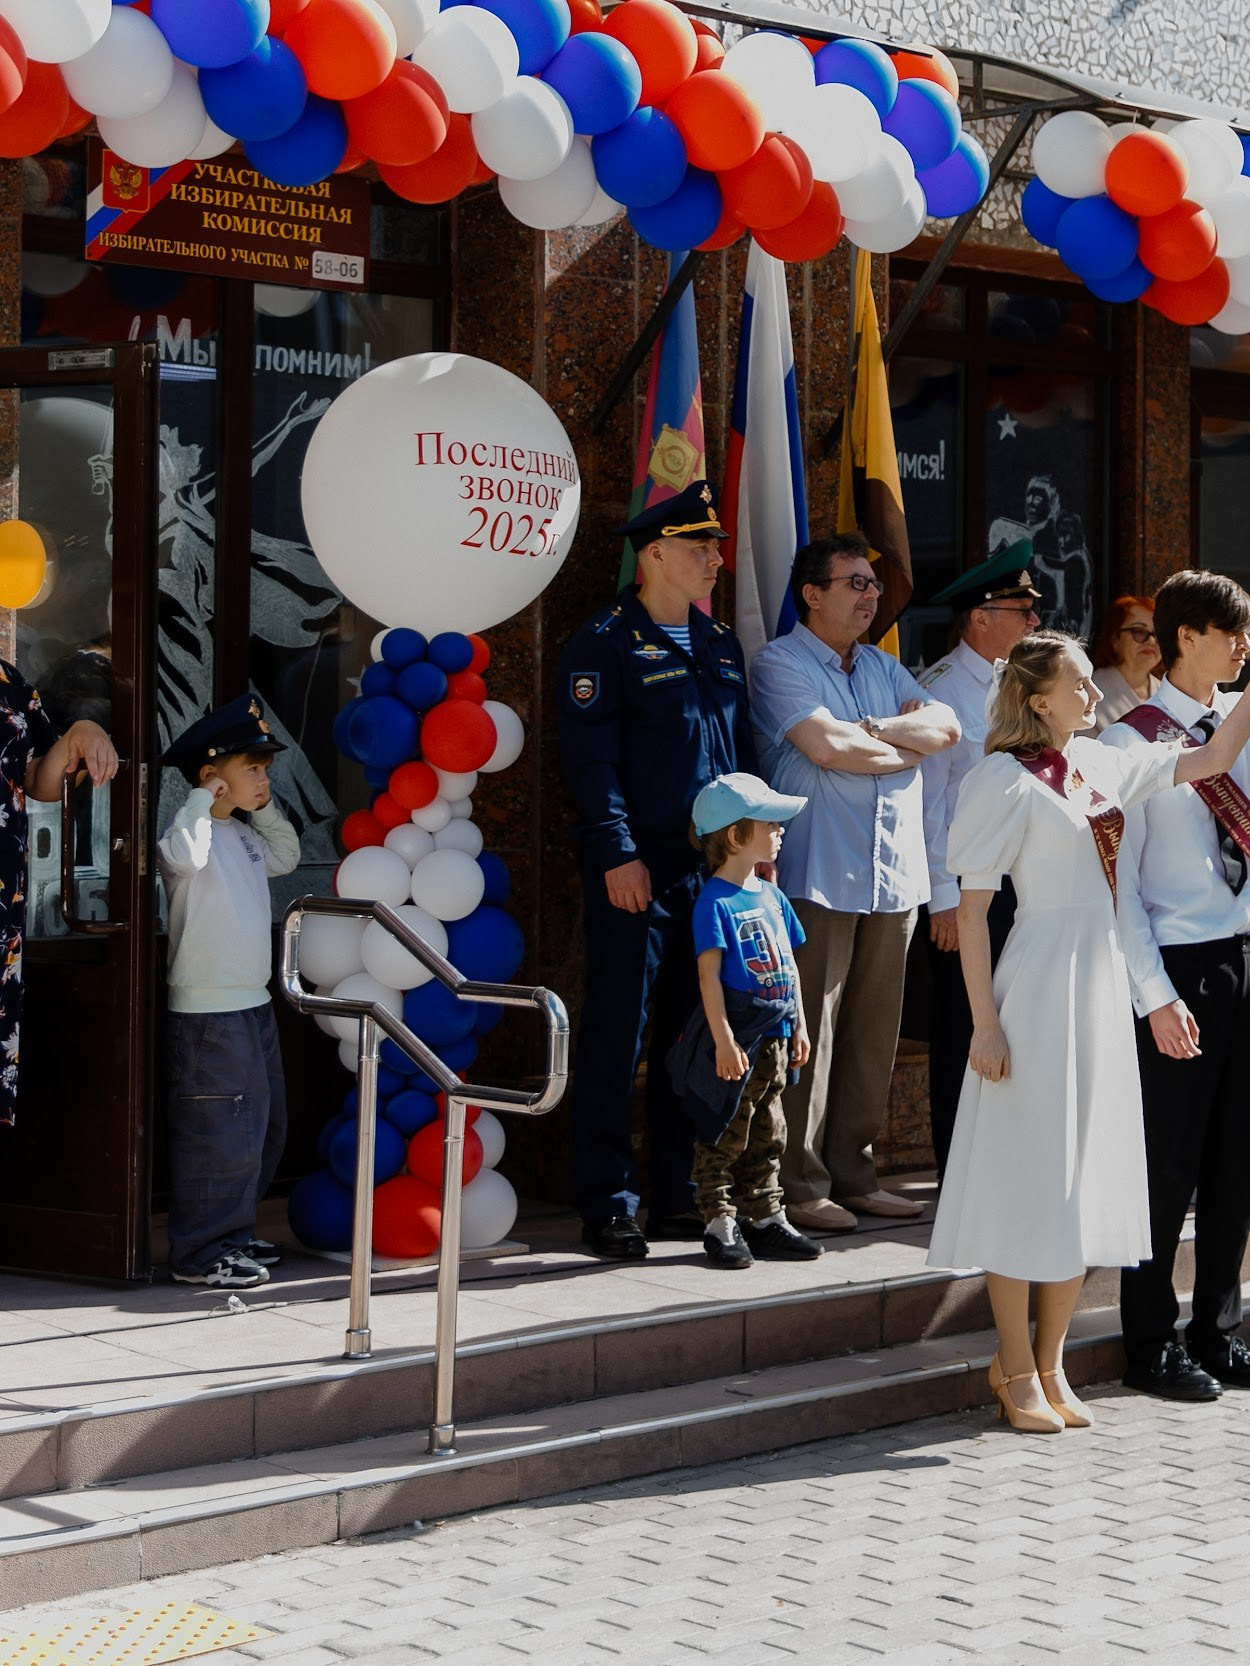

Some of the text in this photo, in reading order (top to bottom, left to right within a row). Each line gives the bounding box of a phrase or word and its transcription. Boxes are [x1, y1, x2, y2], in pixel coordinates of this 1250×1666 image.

[195, 162, 332, 198] УЧАСТКАЯ
[170, 183, 353, 225] ИЗБИРАТЕЛЬНАЯ
[202, 211, 322, 244] КОМИССИЯ
[98, 232, 227, 261] ИЗБИРАТЕЛЬНОГО
[231, 248, 290, 269] УЧАСТКА
[294, 255, 310, 271] №
[156, 314, 216, 366] Мы
[414, 431, 576, 485] Последний
[458, 475, 562, 511] звонок
[460, 506, 561, 558] 2025г.
